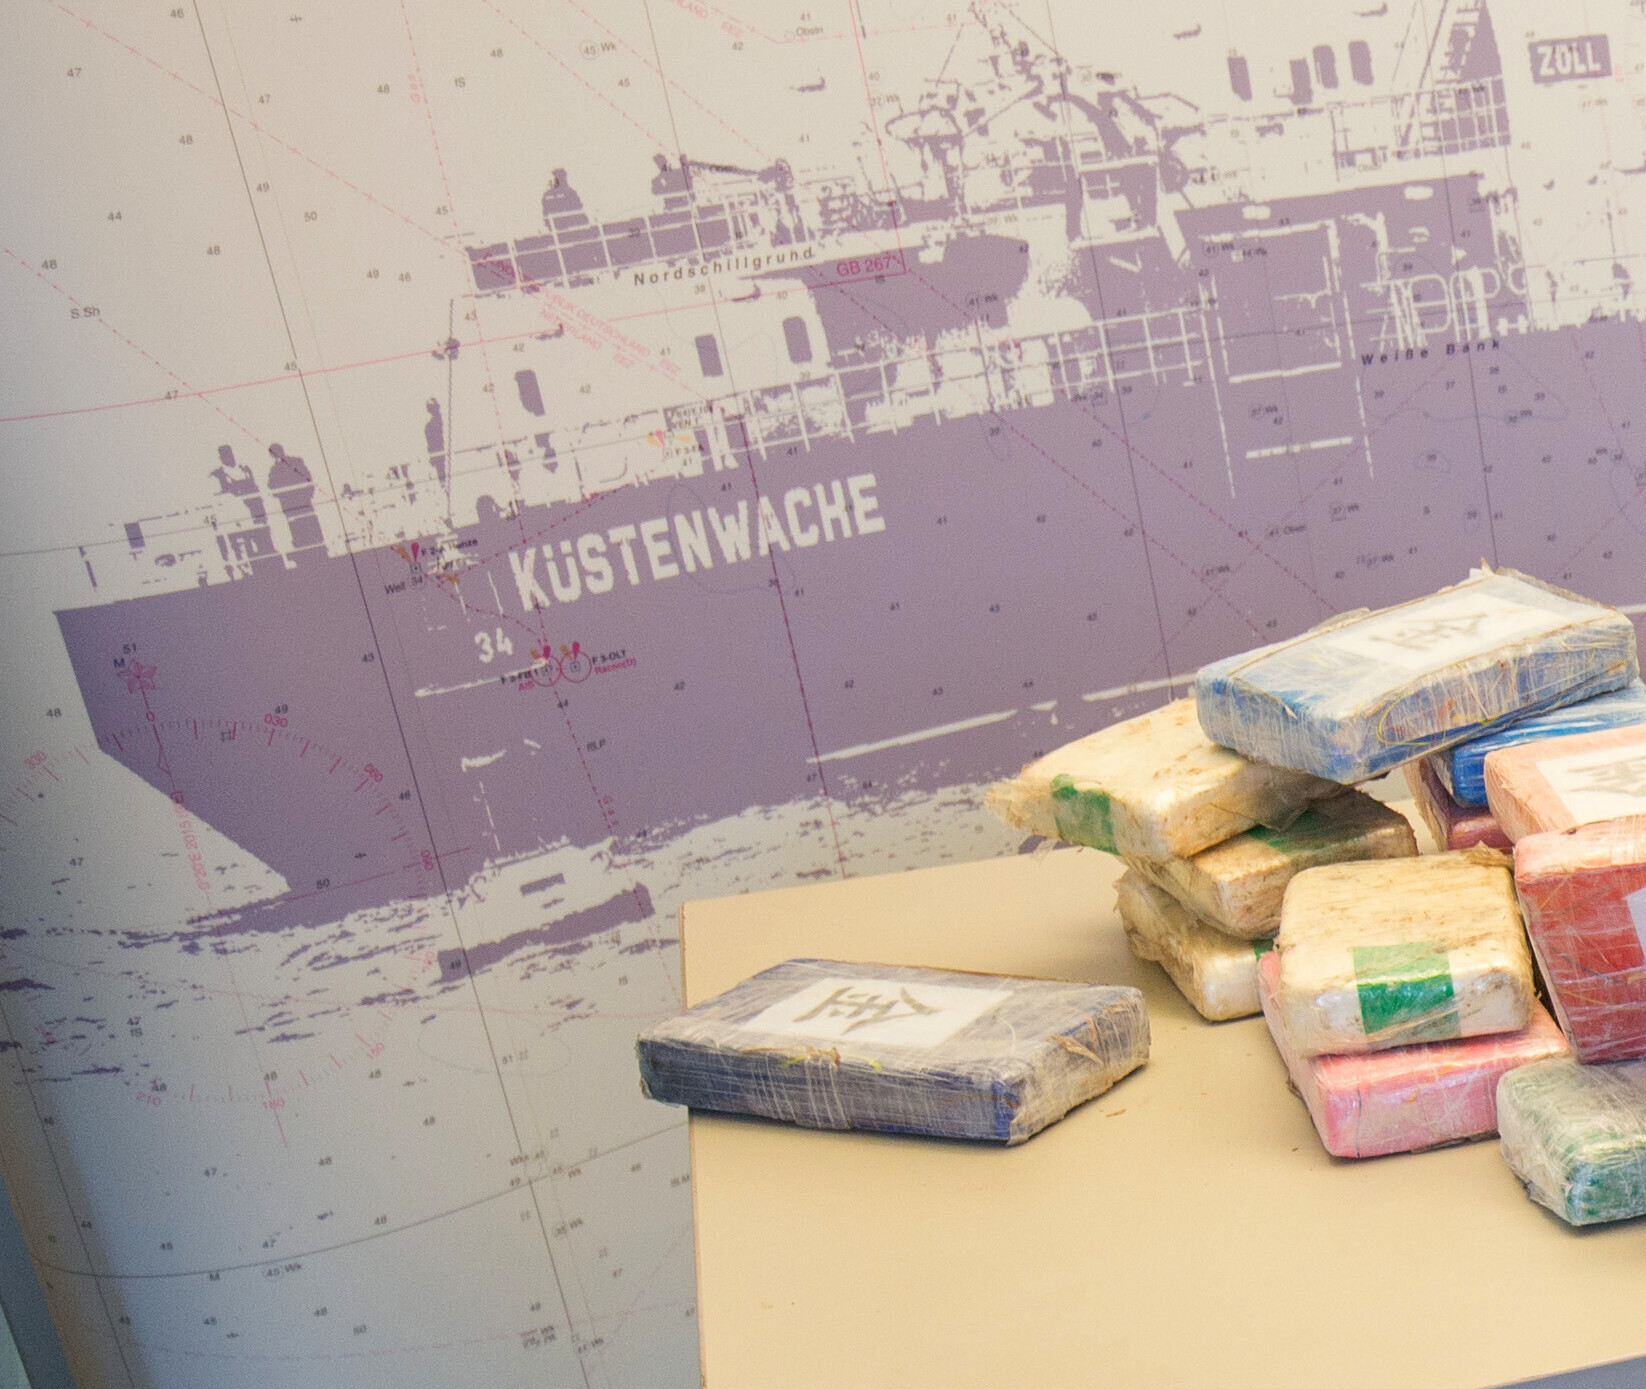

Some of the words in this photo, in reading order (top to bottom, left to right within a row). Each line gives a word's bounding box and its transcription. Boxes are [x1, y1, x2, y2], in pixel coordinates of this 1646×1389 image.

[67, 68, 81, 77] 47
[1536, 40, 1601, 78] ZOLL
[108, 211, 122, 221] 44
[42, 259, 57, 269] 48
[634, 244, 815, 287] Nordschillgrund
[837, 260, 861, 277] GB
[1361, 348, 1429, 366] Weiße
[1445, 340, 1500, 357] Bank
[508, 473, 887, 613] KÜSTENWACHE
[474, 627, 513, 663] 34
[792, 985, 943, 1036] 金
